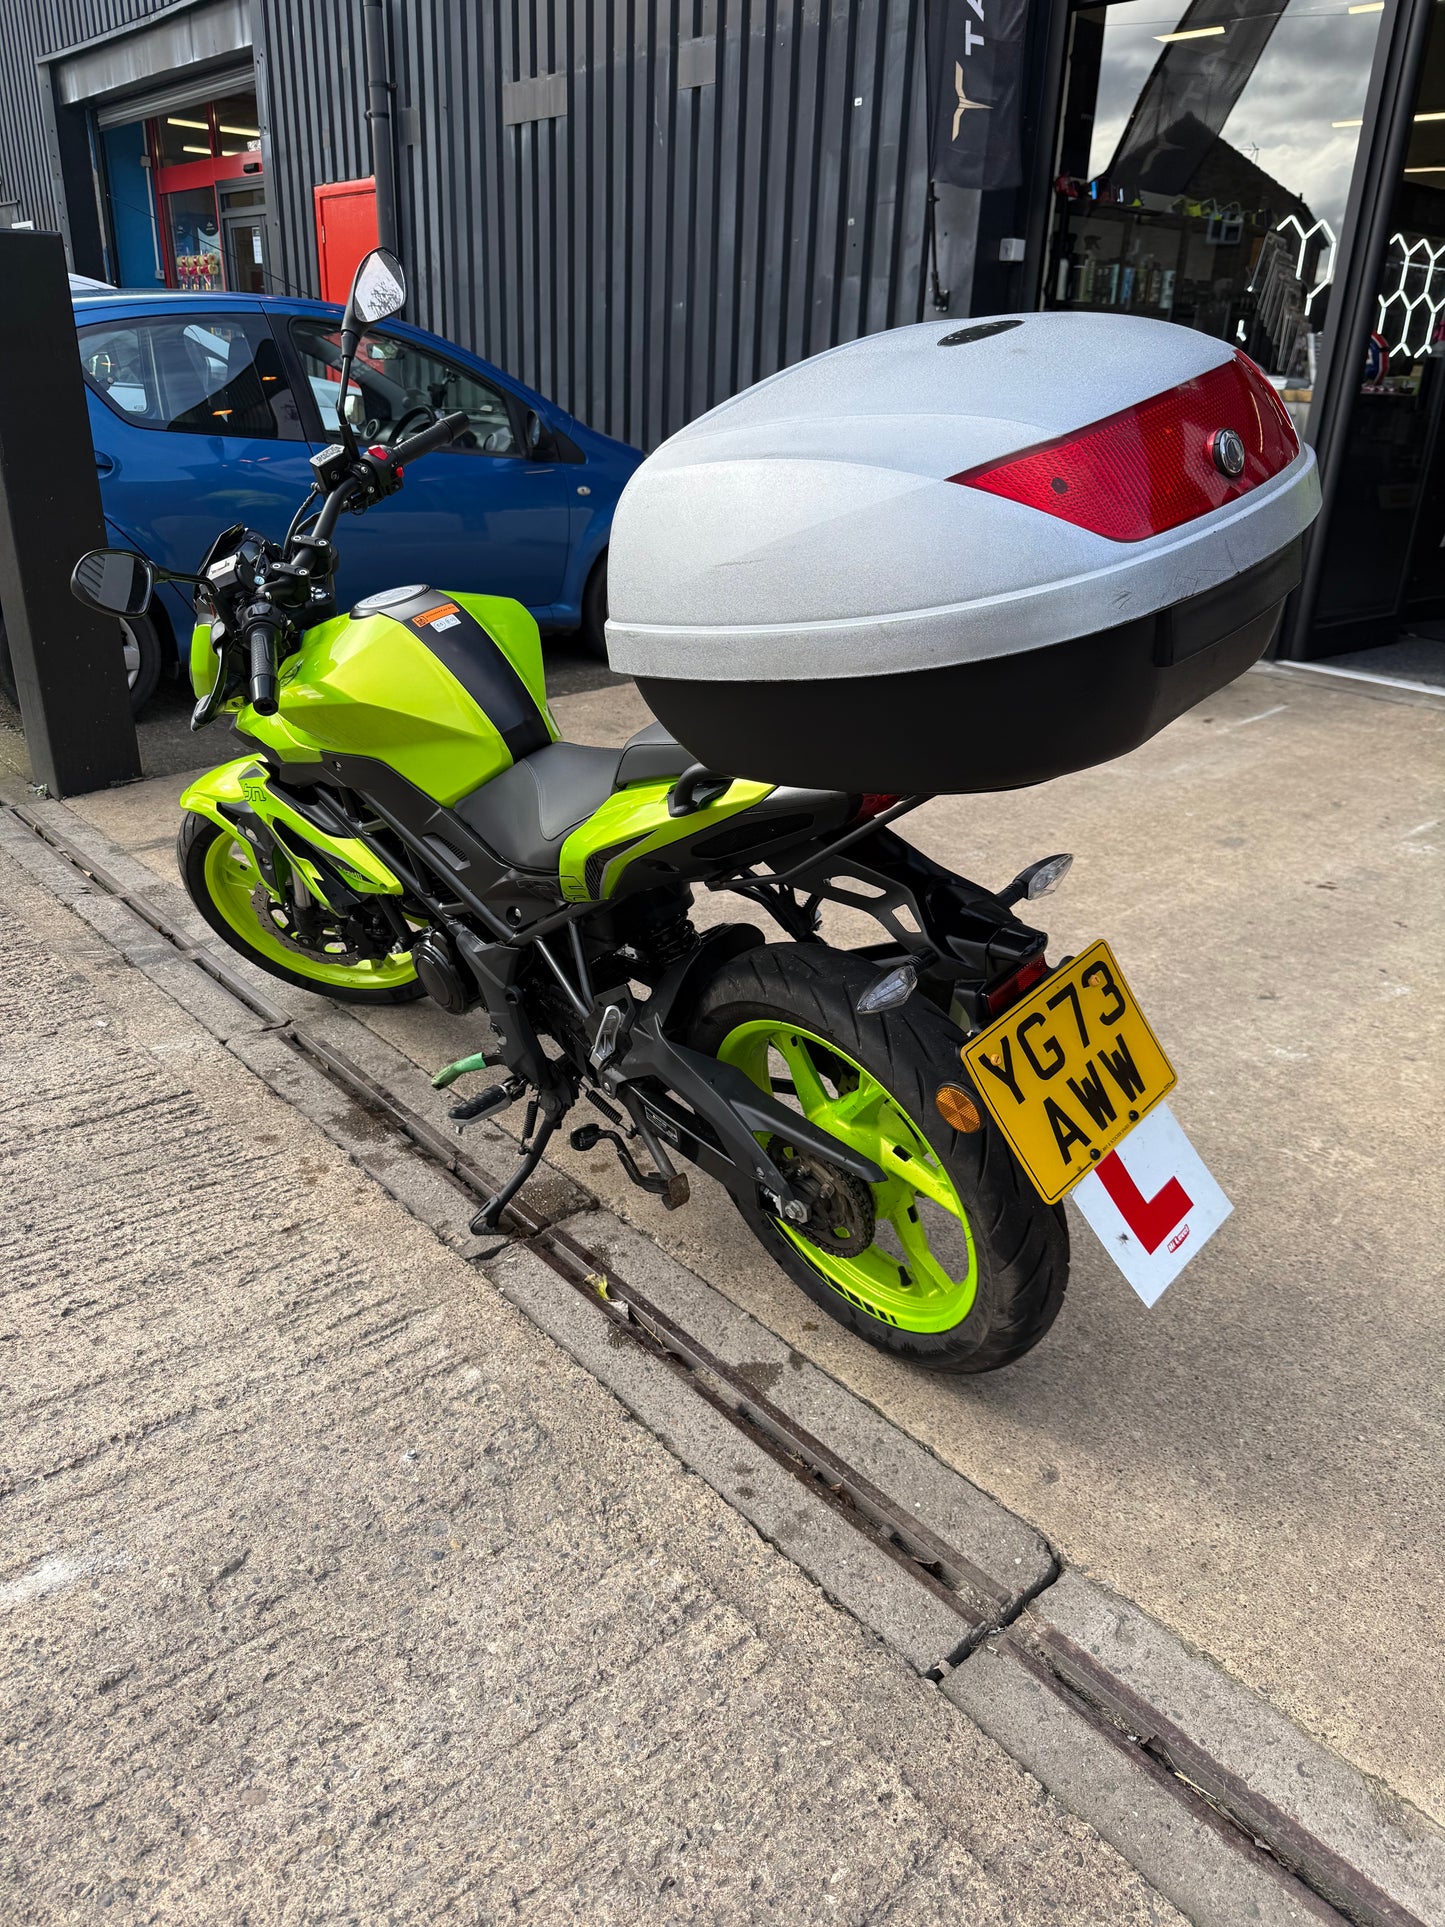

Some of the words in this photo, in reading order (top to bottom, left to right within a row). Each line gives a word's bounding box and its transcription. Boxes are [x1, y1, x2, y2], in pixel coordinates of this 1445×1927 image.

[978, 961, 1126, 1105] YG73
[1043, 1033, 1146, 1166] AWW
[1094, 1150, 1194, 1256] L
